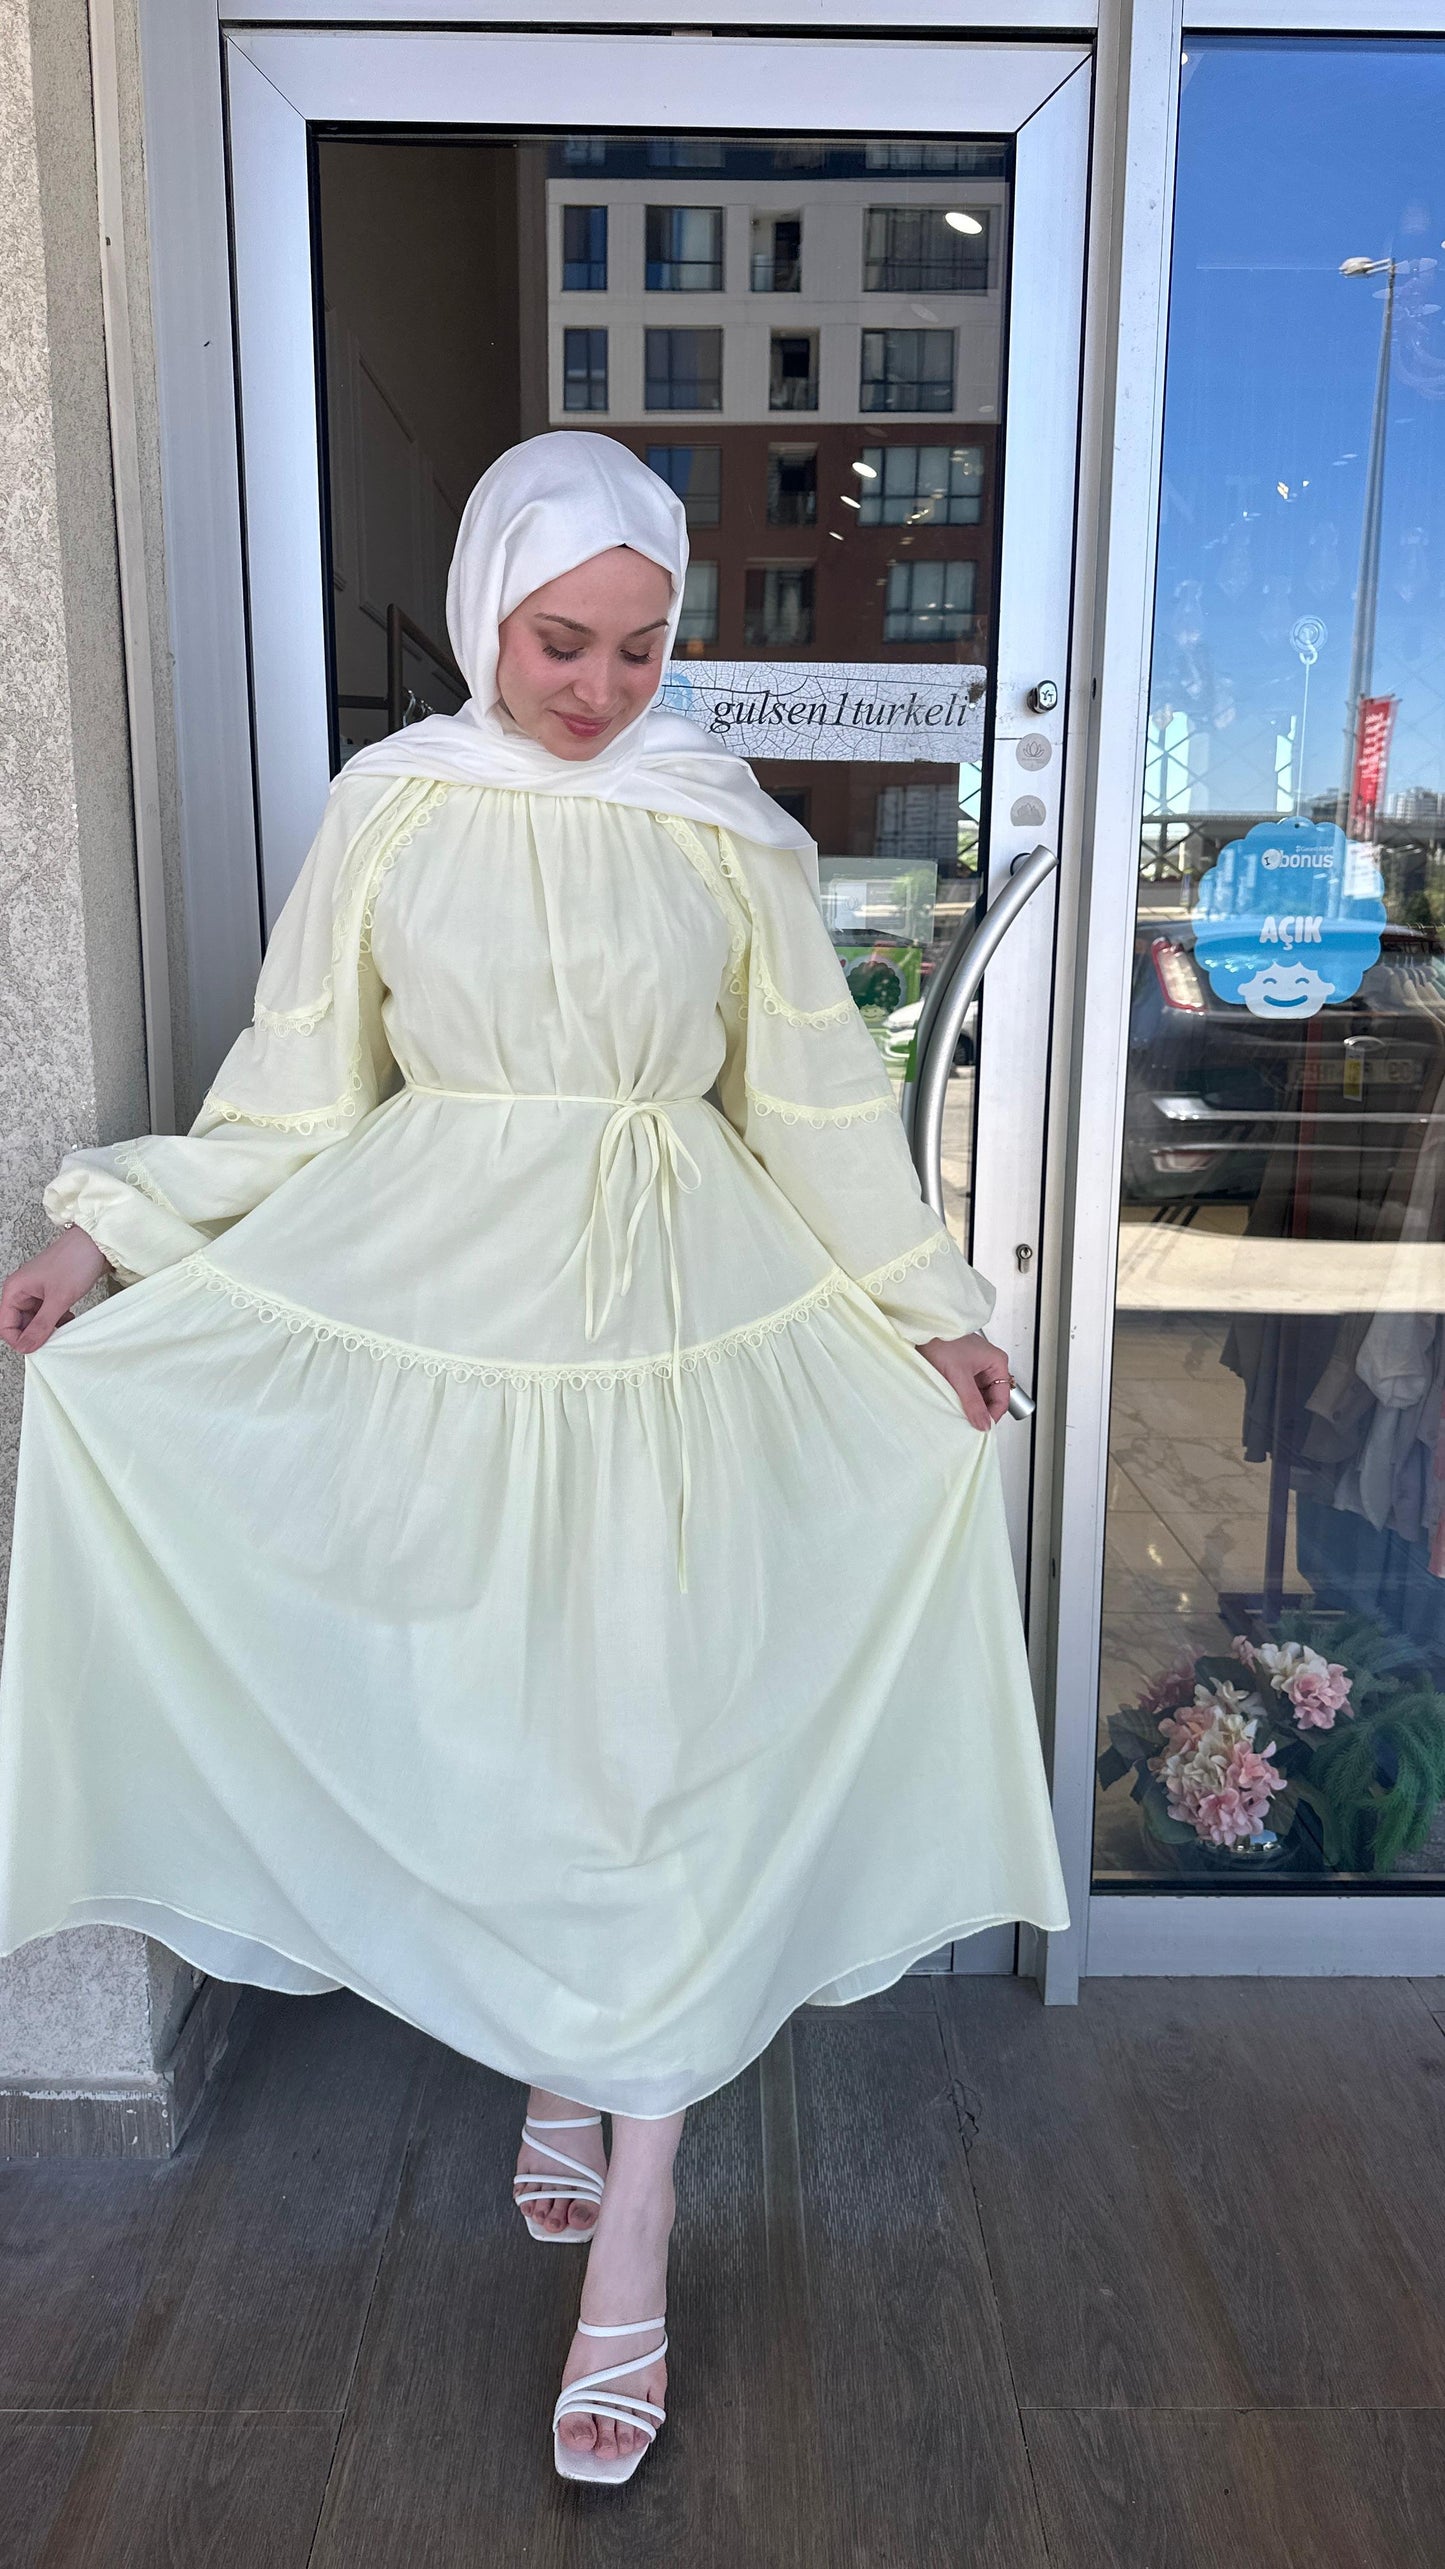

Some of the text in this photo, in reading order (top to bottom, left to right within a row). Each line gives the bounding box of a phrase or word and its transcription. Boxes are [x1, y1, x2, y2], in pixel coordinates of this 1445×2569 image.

[709, 690, 968, 733] gulsen1turkeli
[1279, 849, 1334, 868] bonus
[1259, 915, 1323, 951] AÇIK
